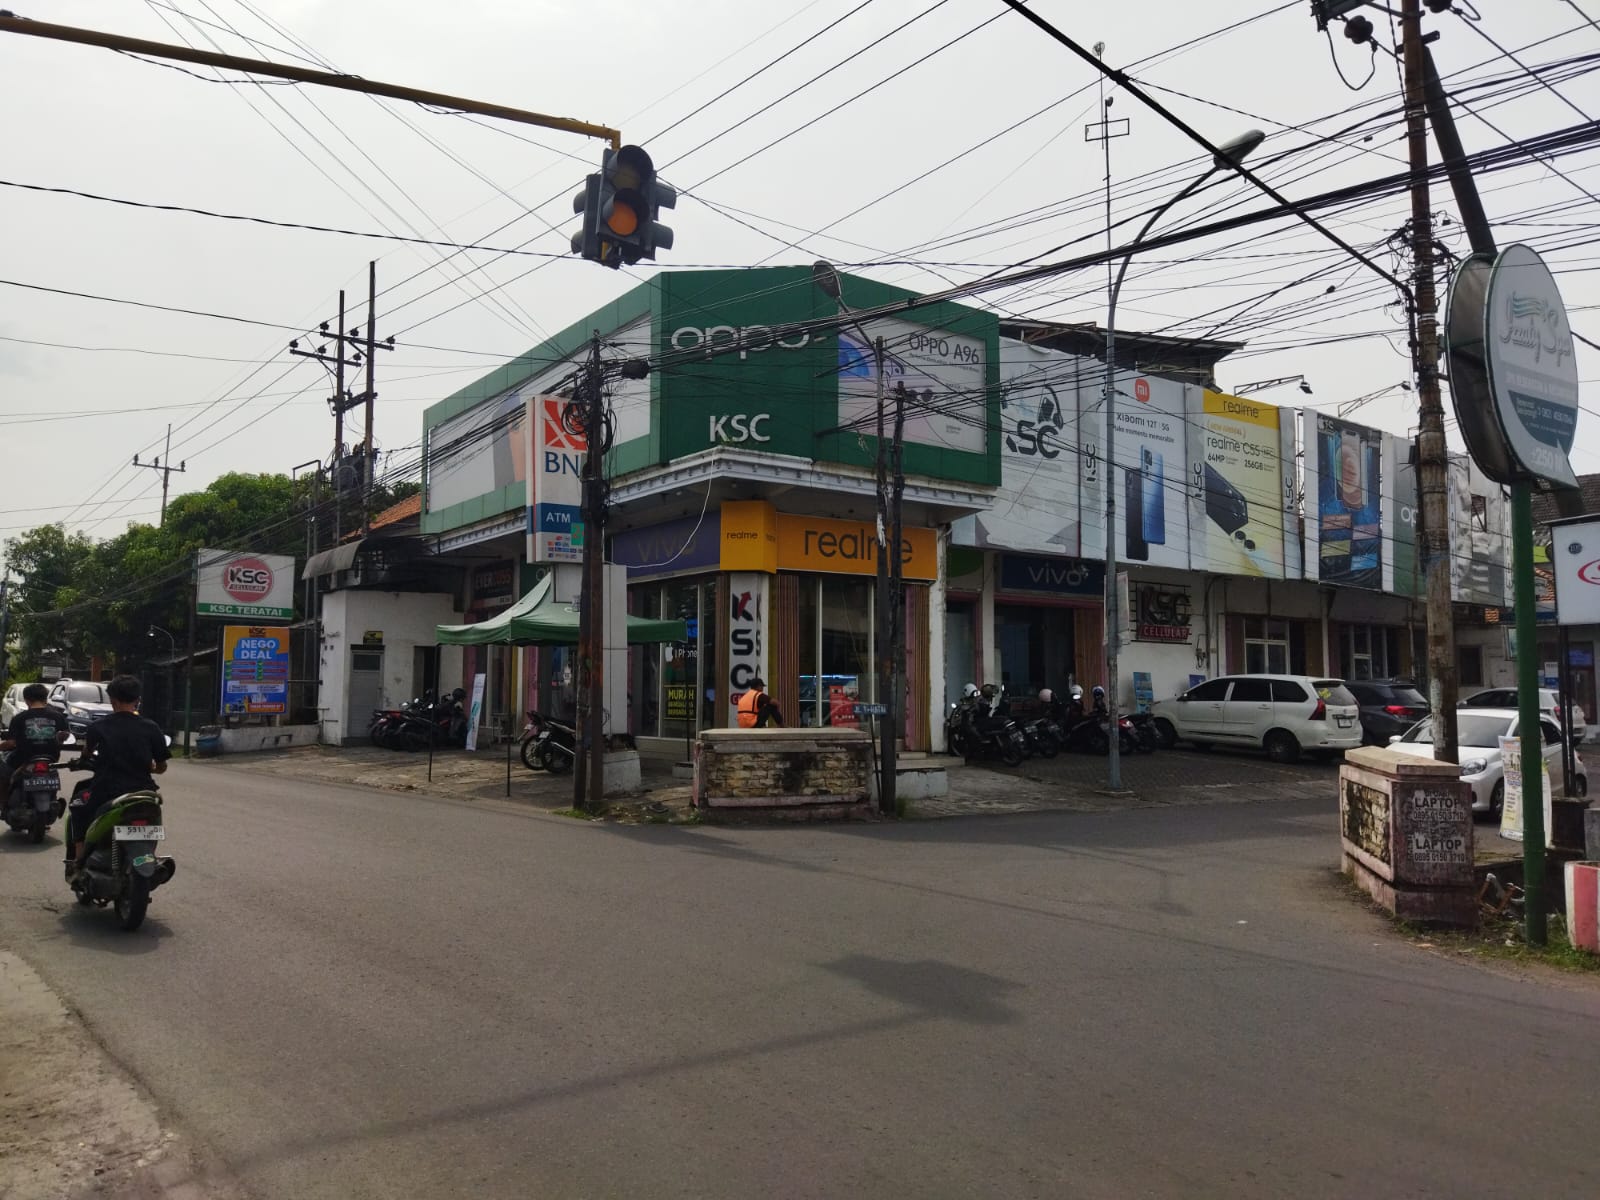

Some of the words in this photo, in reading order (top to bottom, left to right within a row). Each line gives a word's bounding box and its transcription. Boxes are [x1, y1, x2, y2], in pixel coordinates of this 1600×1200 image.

[909, 334, 949, 357] OPPO
[954, 343, 979, 364] A96
[1223, 400, 1259, 418] realme
[709, 413, 770, 442] KSC
[1161, 422, 1170, 431] 5G
[1207, 437, 1240, 453] realme
[1243, 442, 1260, 457] C55
[1244, 459, 1263, 471] 256GB
[546, 512, 571, 523] ATM
[726, 531, 758, 540] realme
[804, 528, 913, 564] realme
[230, 568, 267, 584] KSC
[1028, 562, 1082, 586] vivo
[210, 604, 233, 613] KSC
[237, 606, 282, 616] TERATAI
[1143, 627, 1188, 638] CELLULAR
[241, 640, 276, 649] NEGO
[731, 591, 754, 690] KSC
[240, 650, 272, 659] DEAL
[668, 689, 694, 699] MURAH
[1415, 798, 1459, 808] LAPTOP
[1415, 839, 1462, 849] LAPTOP
